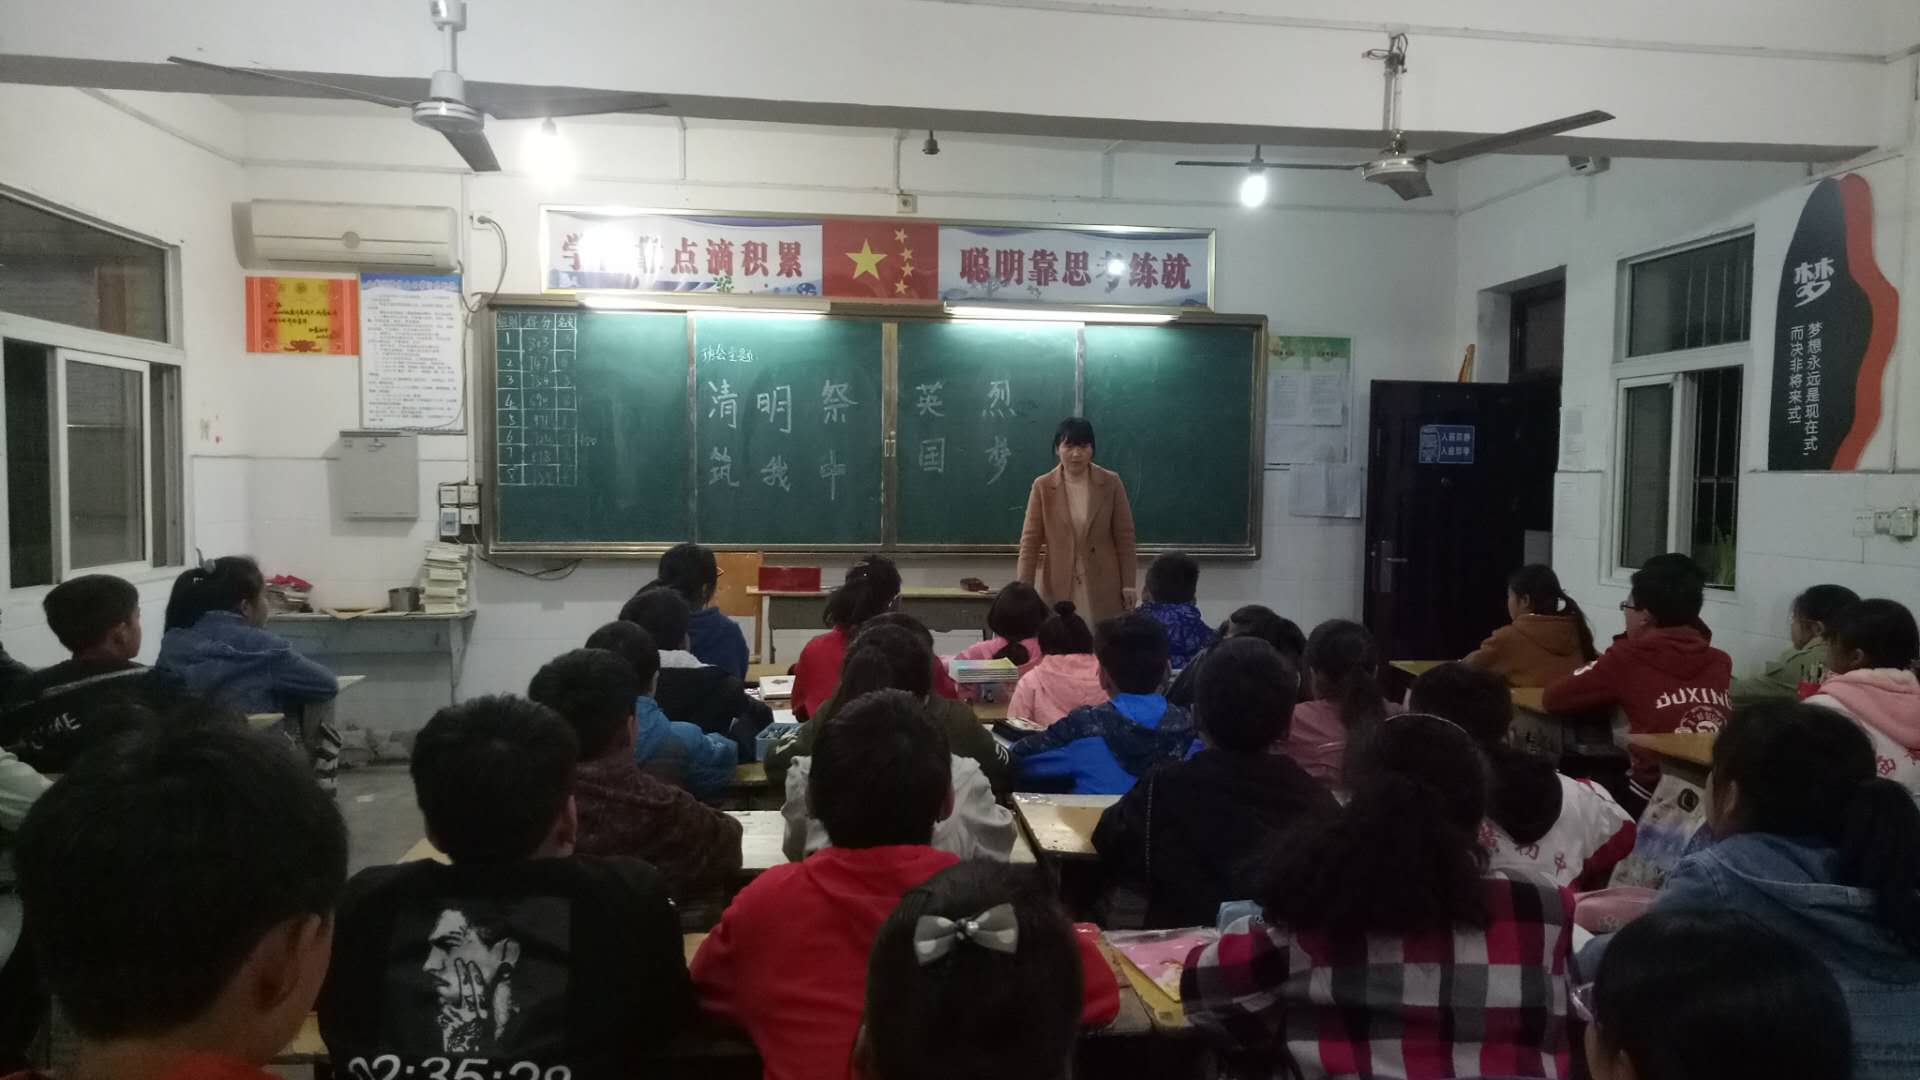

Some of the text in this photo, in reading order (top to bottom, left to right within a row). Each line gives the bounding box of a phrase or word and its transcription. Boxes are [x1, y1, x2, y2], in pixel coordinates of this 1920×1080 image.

[562, 233, 803, 279] 学点滴积累
[1794, 257, 1835, 308] 梦
